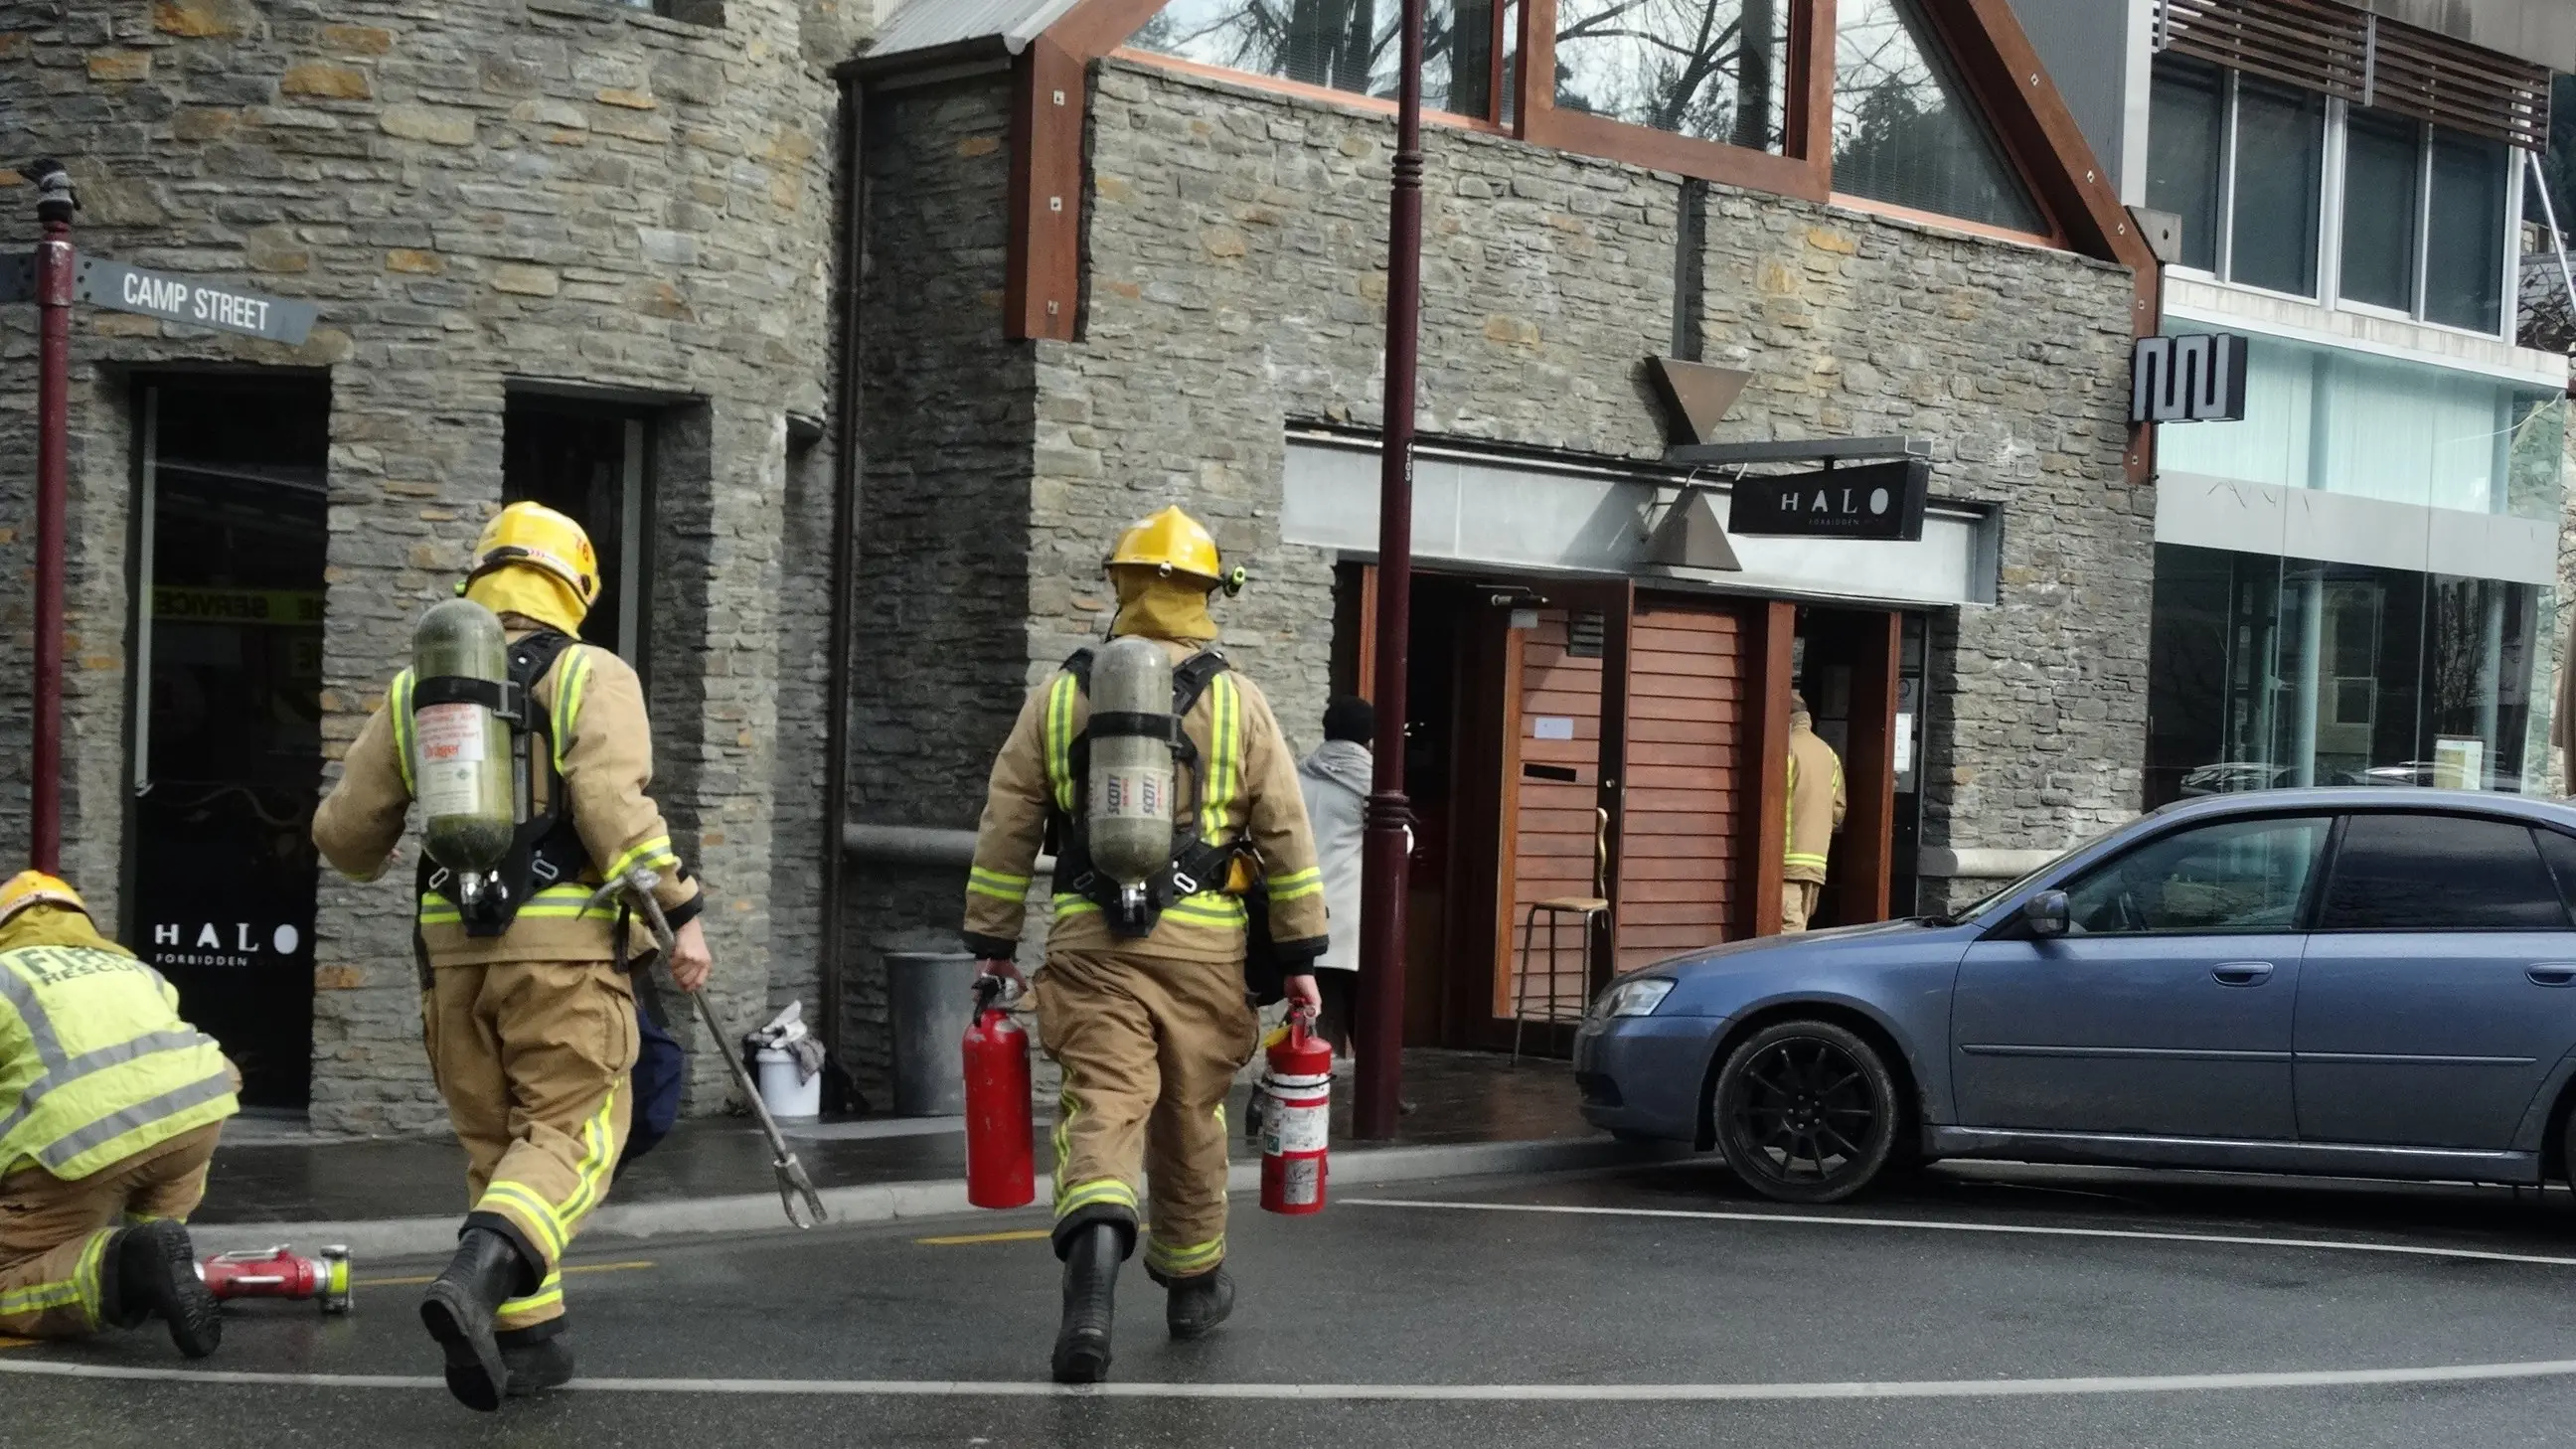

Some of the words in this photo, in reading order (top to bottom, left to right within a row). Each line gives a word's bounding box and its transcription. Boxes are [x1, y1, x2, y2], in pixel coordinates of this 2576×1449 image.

[123, 272, 188, 313] CAMP
[193, 287, 269, 331] STREET
[1781, 487, 1888, 516] HALO
[1107, 774, 1120, 815] SCOTT
[1143, 774, 1155, 814] SCOTT
[154, 922, 298, 955] HALO
[155, 953, 247, 967] FORBIDDEN
